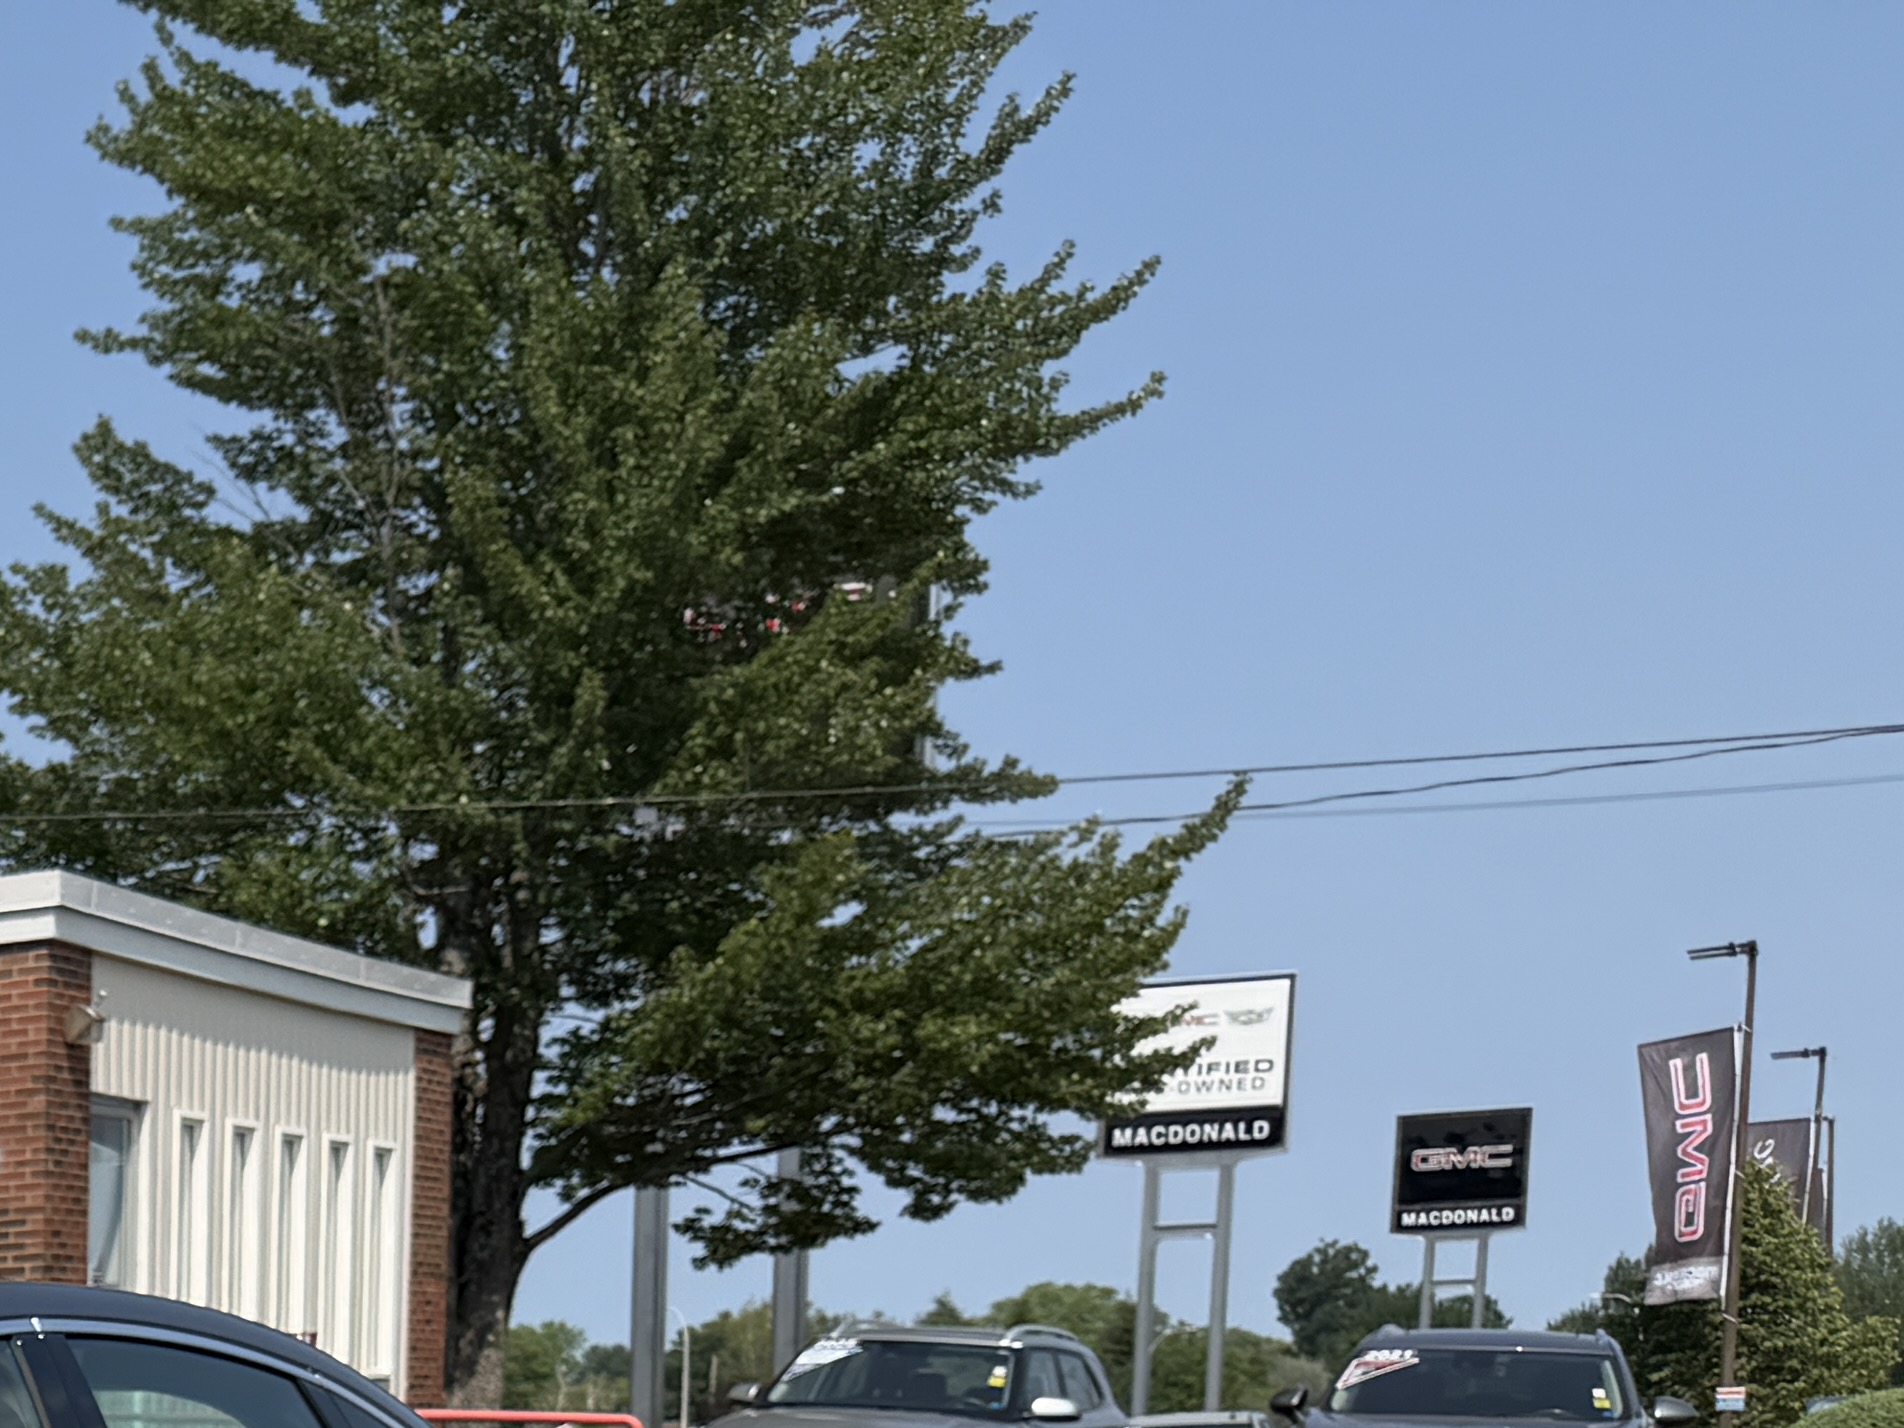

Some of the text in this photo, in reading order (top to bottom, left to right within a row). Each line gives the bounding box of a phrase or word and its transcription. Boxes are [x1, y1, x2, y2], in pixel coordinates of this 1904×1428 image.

[1111, 1119, 1271, 1149] MACDONALD
[1410, 1143, 1514, 1172] GMC
[1400, 1206, 1515, 1228] MACDONALD
